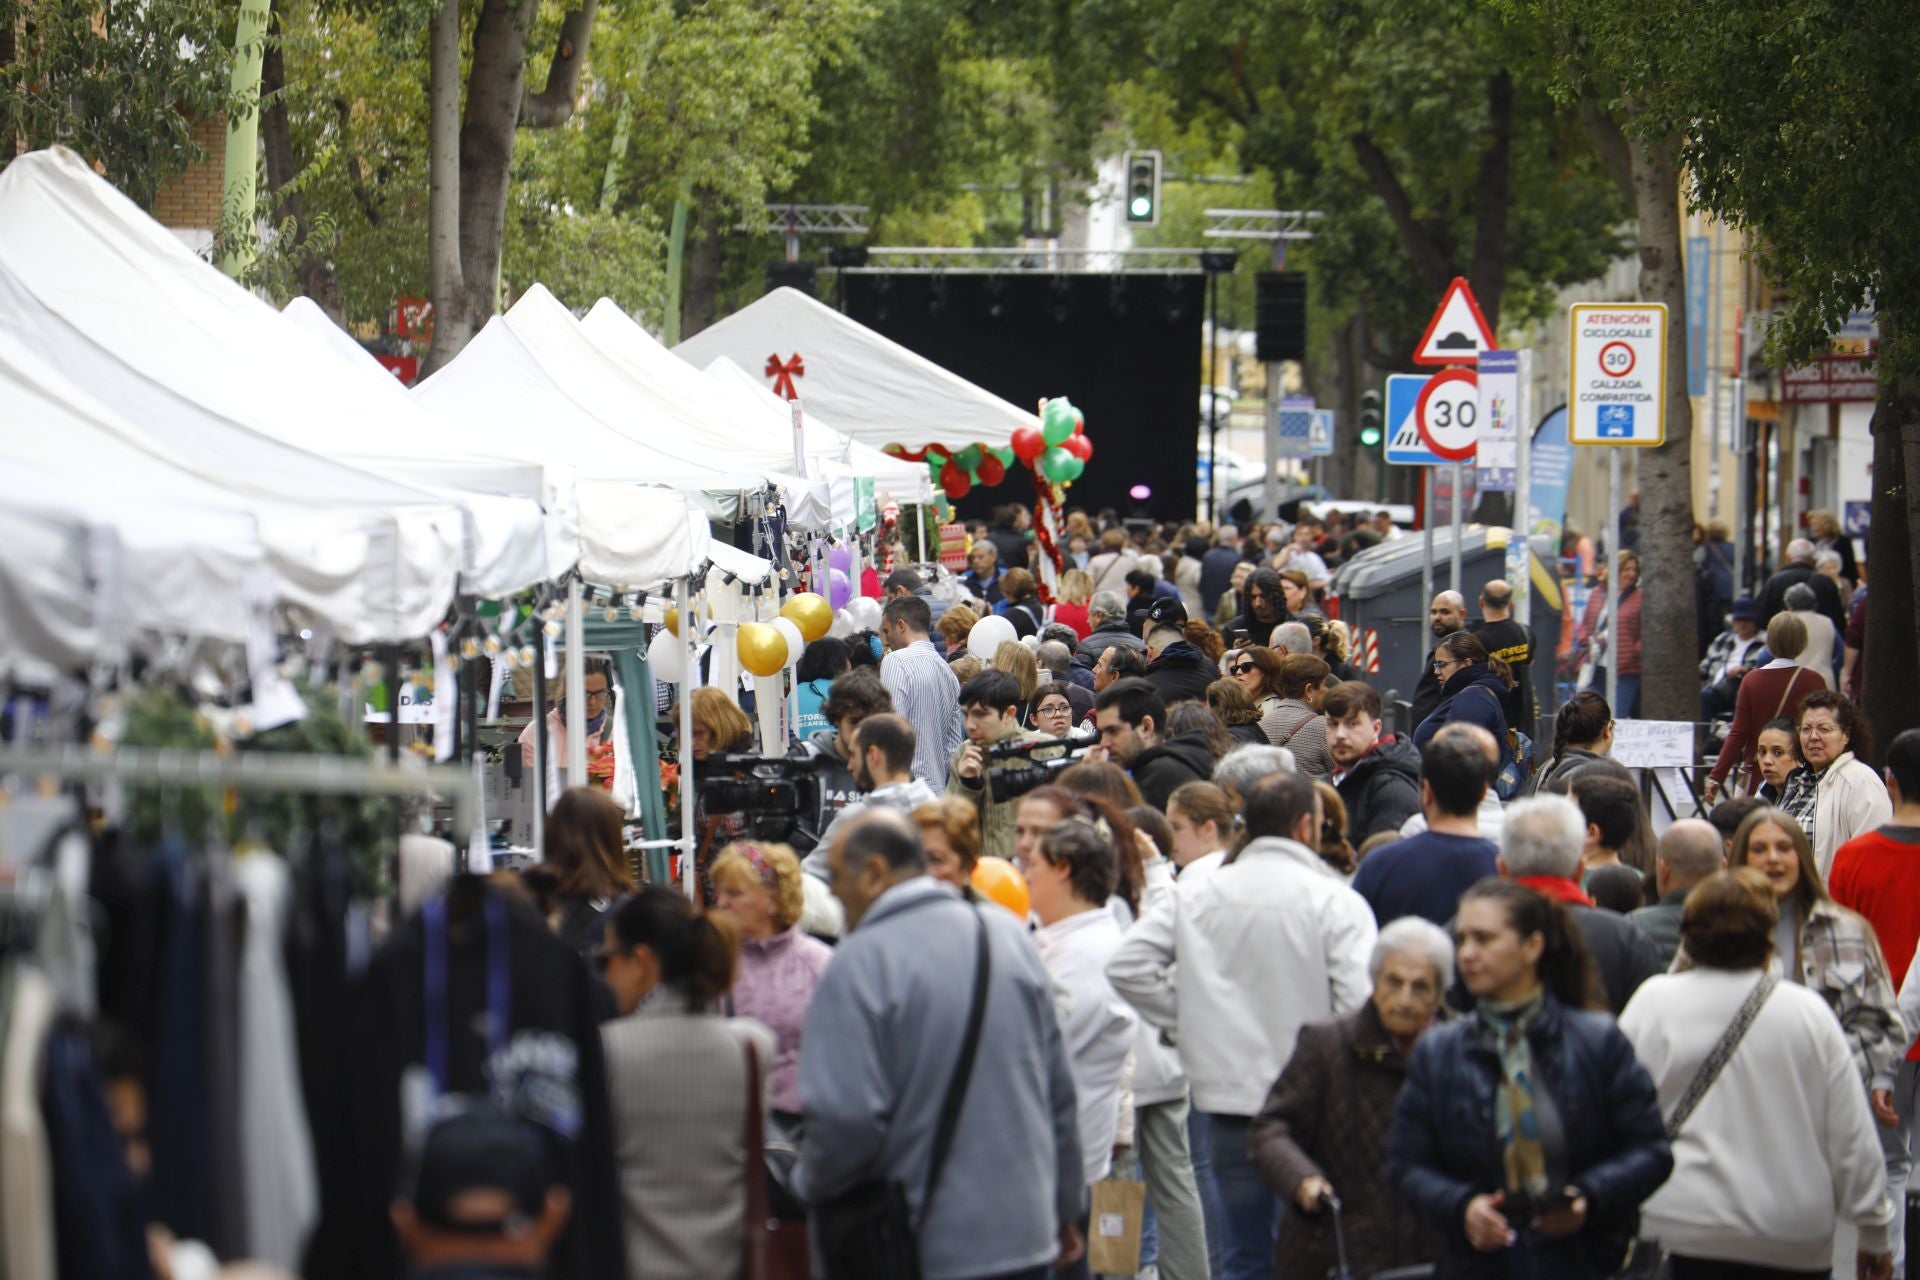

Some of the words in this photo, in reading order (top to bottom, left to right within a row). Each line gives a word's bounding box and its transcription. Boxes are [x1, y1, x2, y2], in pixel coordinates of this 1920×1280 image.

[1587, 313, 1650, 324] ATENCIÓN
[1583, 329, 1653, 338] CICLOCALLE
[1606, 353, 1628, 365] 30
[1591, 380, 1642, 389] CALZADA
[1580, 393, 1653, 402] COMPARTIDA
[1434, 400, 1476, 428] 30
